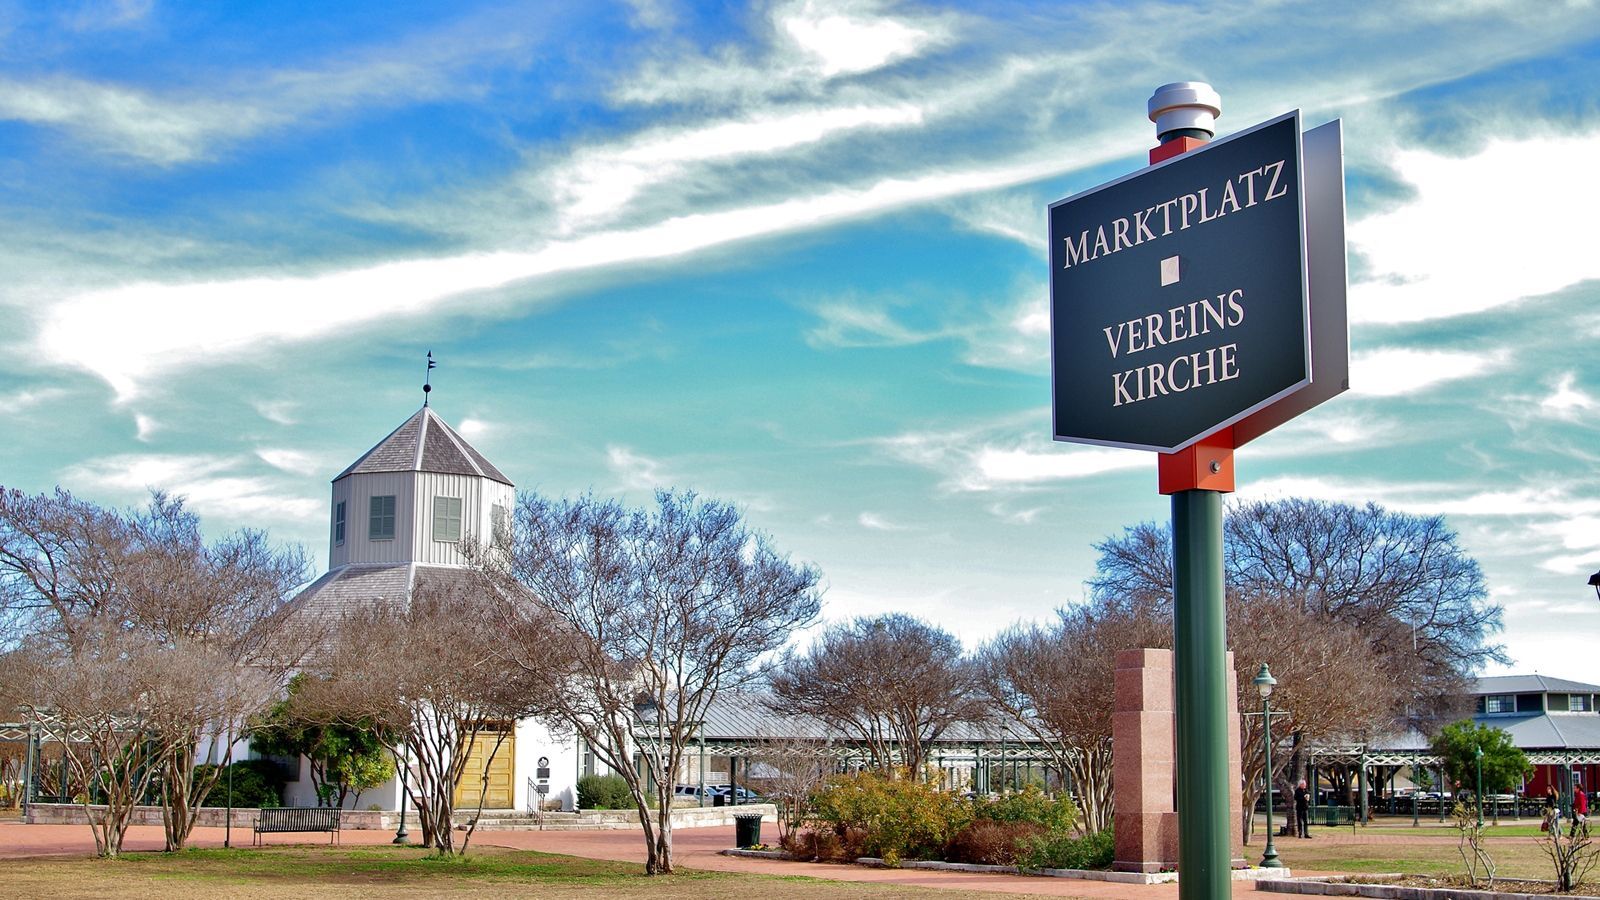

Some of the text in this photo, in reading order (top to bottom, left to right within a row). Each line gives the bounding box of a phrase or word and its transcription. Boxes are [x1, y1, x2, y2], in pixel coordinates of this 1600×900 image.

[1063, 159, 1288, 269] MARKTPLATZ
[1103, 289, 1244, 359] VEREINS
[1112, 343, 1240, 407] KIRCHE
